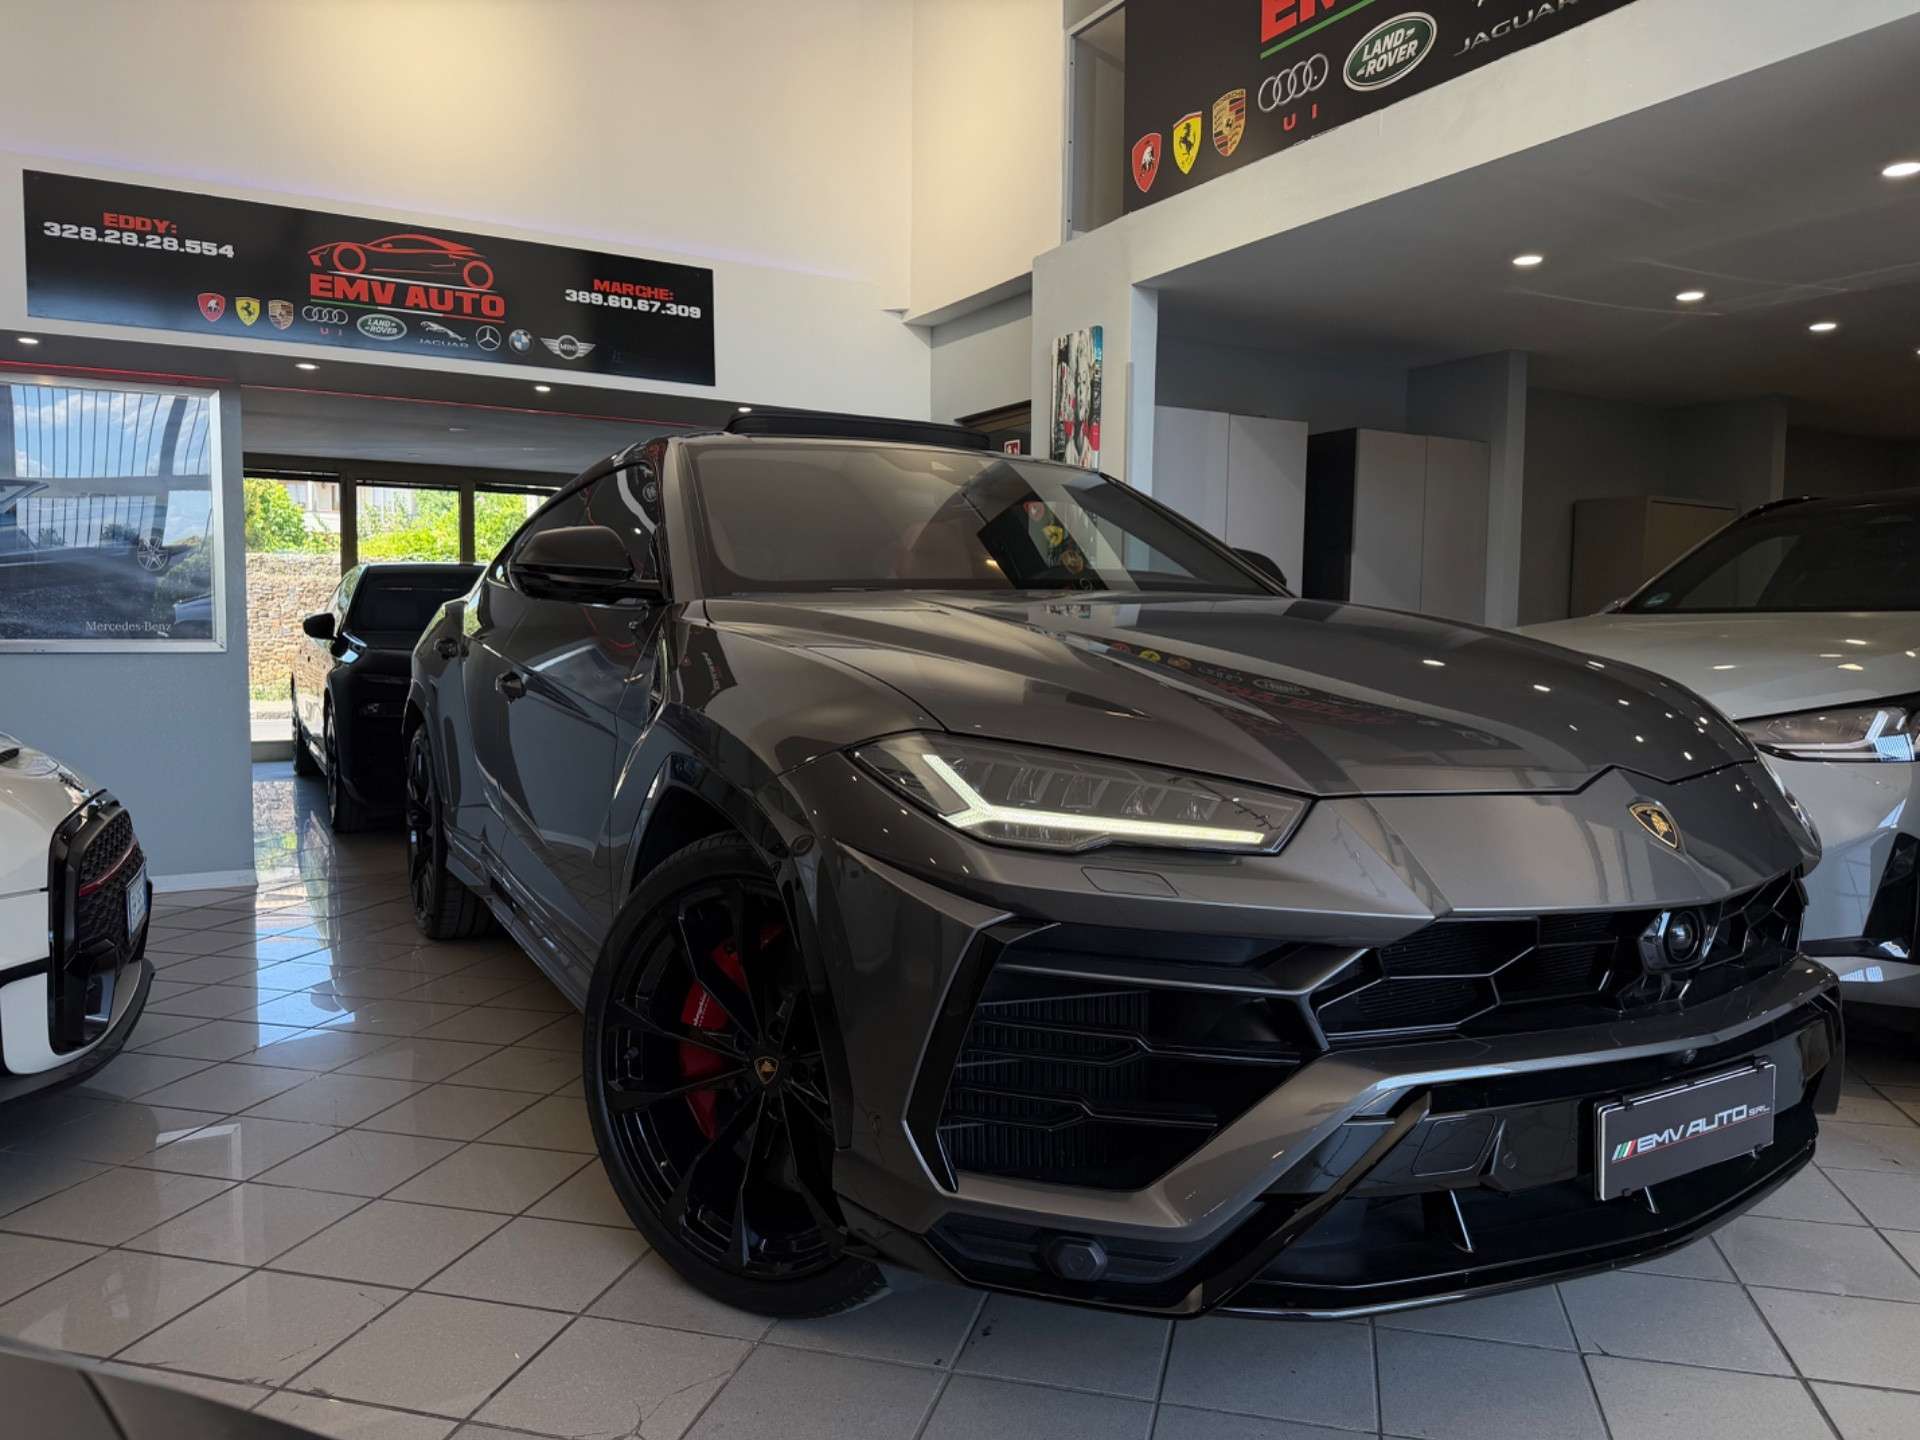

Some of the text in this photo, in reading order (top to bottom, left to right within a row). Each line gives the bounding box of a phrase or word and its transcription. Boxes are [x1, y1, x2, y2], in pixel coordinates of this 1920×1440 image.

[1361, 28, 1405, 62] LAND
[1364, 40, 1419, 79] ROVER
[103, 212, 177, 234] EDDY:
[43, 221, 235, 258] 328.28.28.554
[310, 273, 506, 318] EMV AUTO
[565, 288, 701, 319] 389.60.67.309
[593, 279, 675, 300] MARCHE:
[367, 319, 391, 328] LAND
[370, 324, 398, 335] ROVER
[1637, 1124, 1684, 1153] EMV
[1686, 1104, 1748, 1137] AUTO
